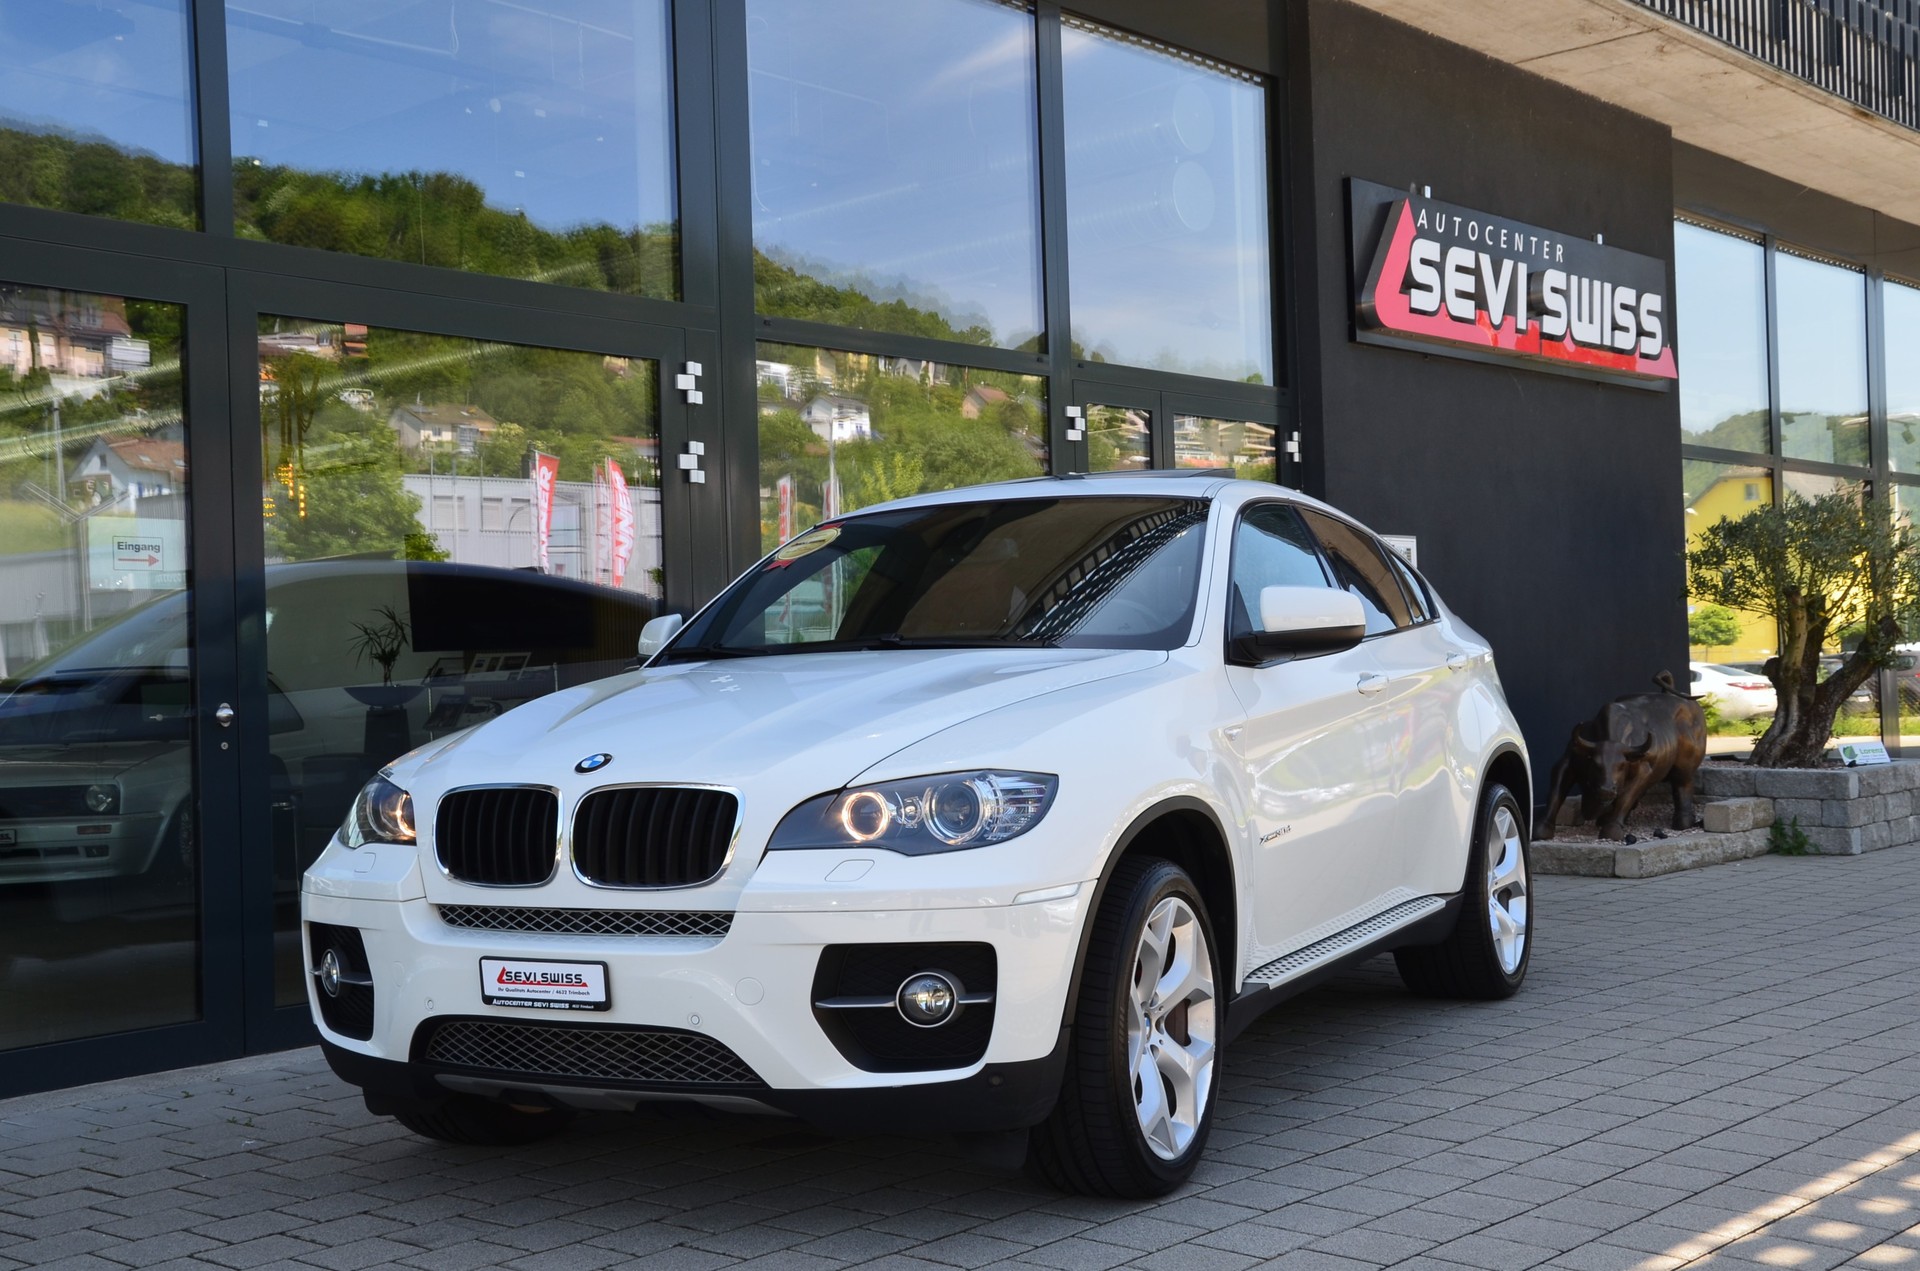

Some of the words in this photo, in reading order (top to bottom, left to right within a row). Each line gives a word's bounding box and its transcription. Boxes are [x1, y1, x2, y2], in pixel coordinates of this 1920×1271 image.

[1417, 208, 1564, 263] AUTOCENTER
[1410, 238, 1528, 331] SEVI
[1542, 268, 1663, 356] SWISS
[117, 541, 161, 553] Eingang
[505, 971, 536, 982] SEVI
[541, 972, 583, 984] SWISS
